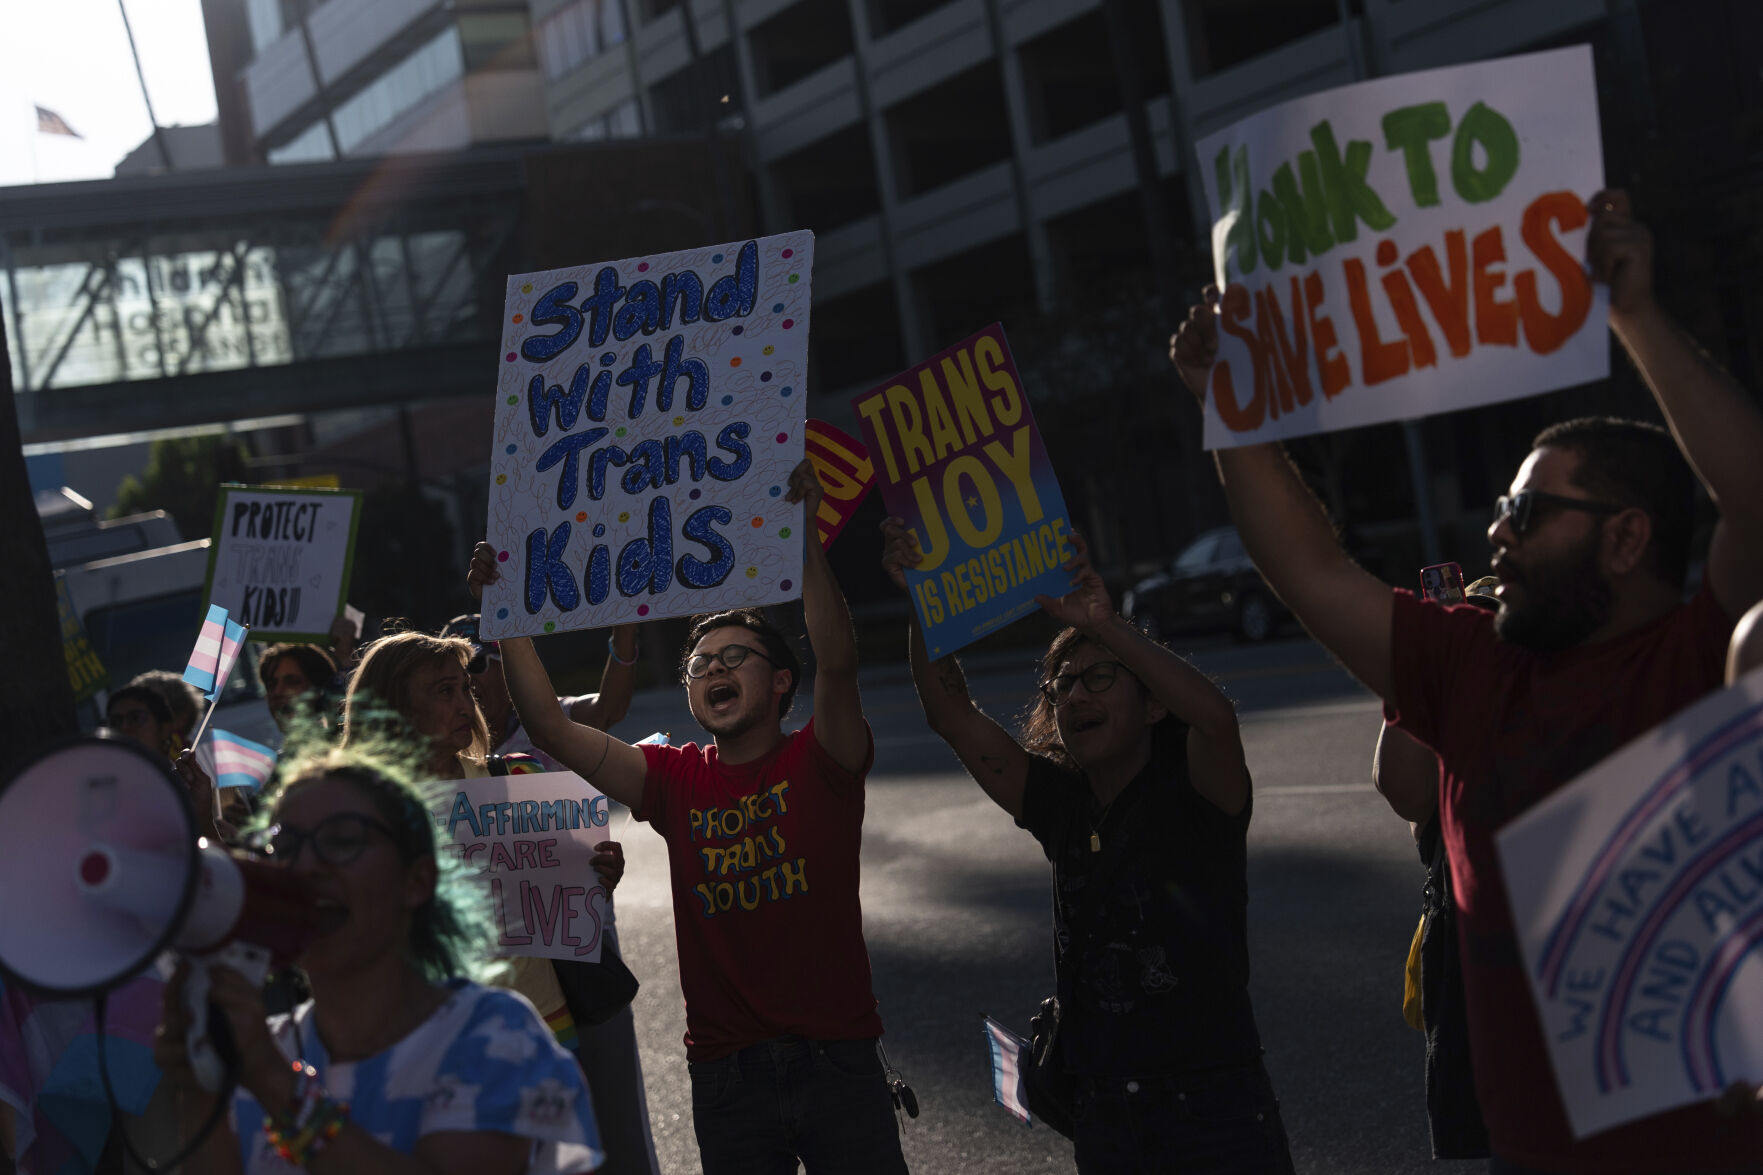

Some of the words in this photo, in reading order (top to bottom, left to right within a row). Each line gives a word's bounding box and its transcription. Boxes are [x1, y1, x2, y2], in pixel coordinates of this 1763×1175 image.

[1382, 100, 1519, 207] TO
[521, 240, 759, 363] Stand
[1212, 270, 1350, 432] SAVE
[858, 336, 1022, 484] TRANS
[536, 422, 753, 511] Trans
[908, 425, 1044, 572] JOY
[230, 543, 304, 585] TRANS
[231, 500, 323, 543] PROTECT
[524, 497, 735, 614] Kids
[915, 577, 944, 628] IS
[941, 518, 1072, 616] RESISTANCE
[689, 780, 789, 842] PROTECT
[491, 878, 605, 956] LIVES
[692, 858, 808, 918] YOUTH
[1556, 966, 1607, 1045] WE
[1591, 806, 1712, 944] HAVE
[1627, 938, 1703, 1043] AND
